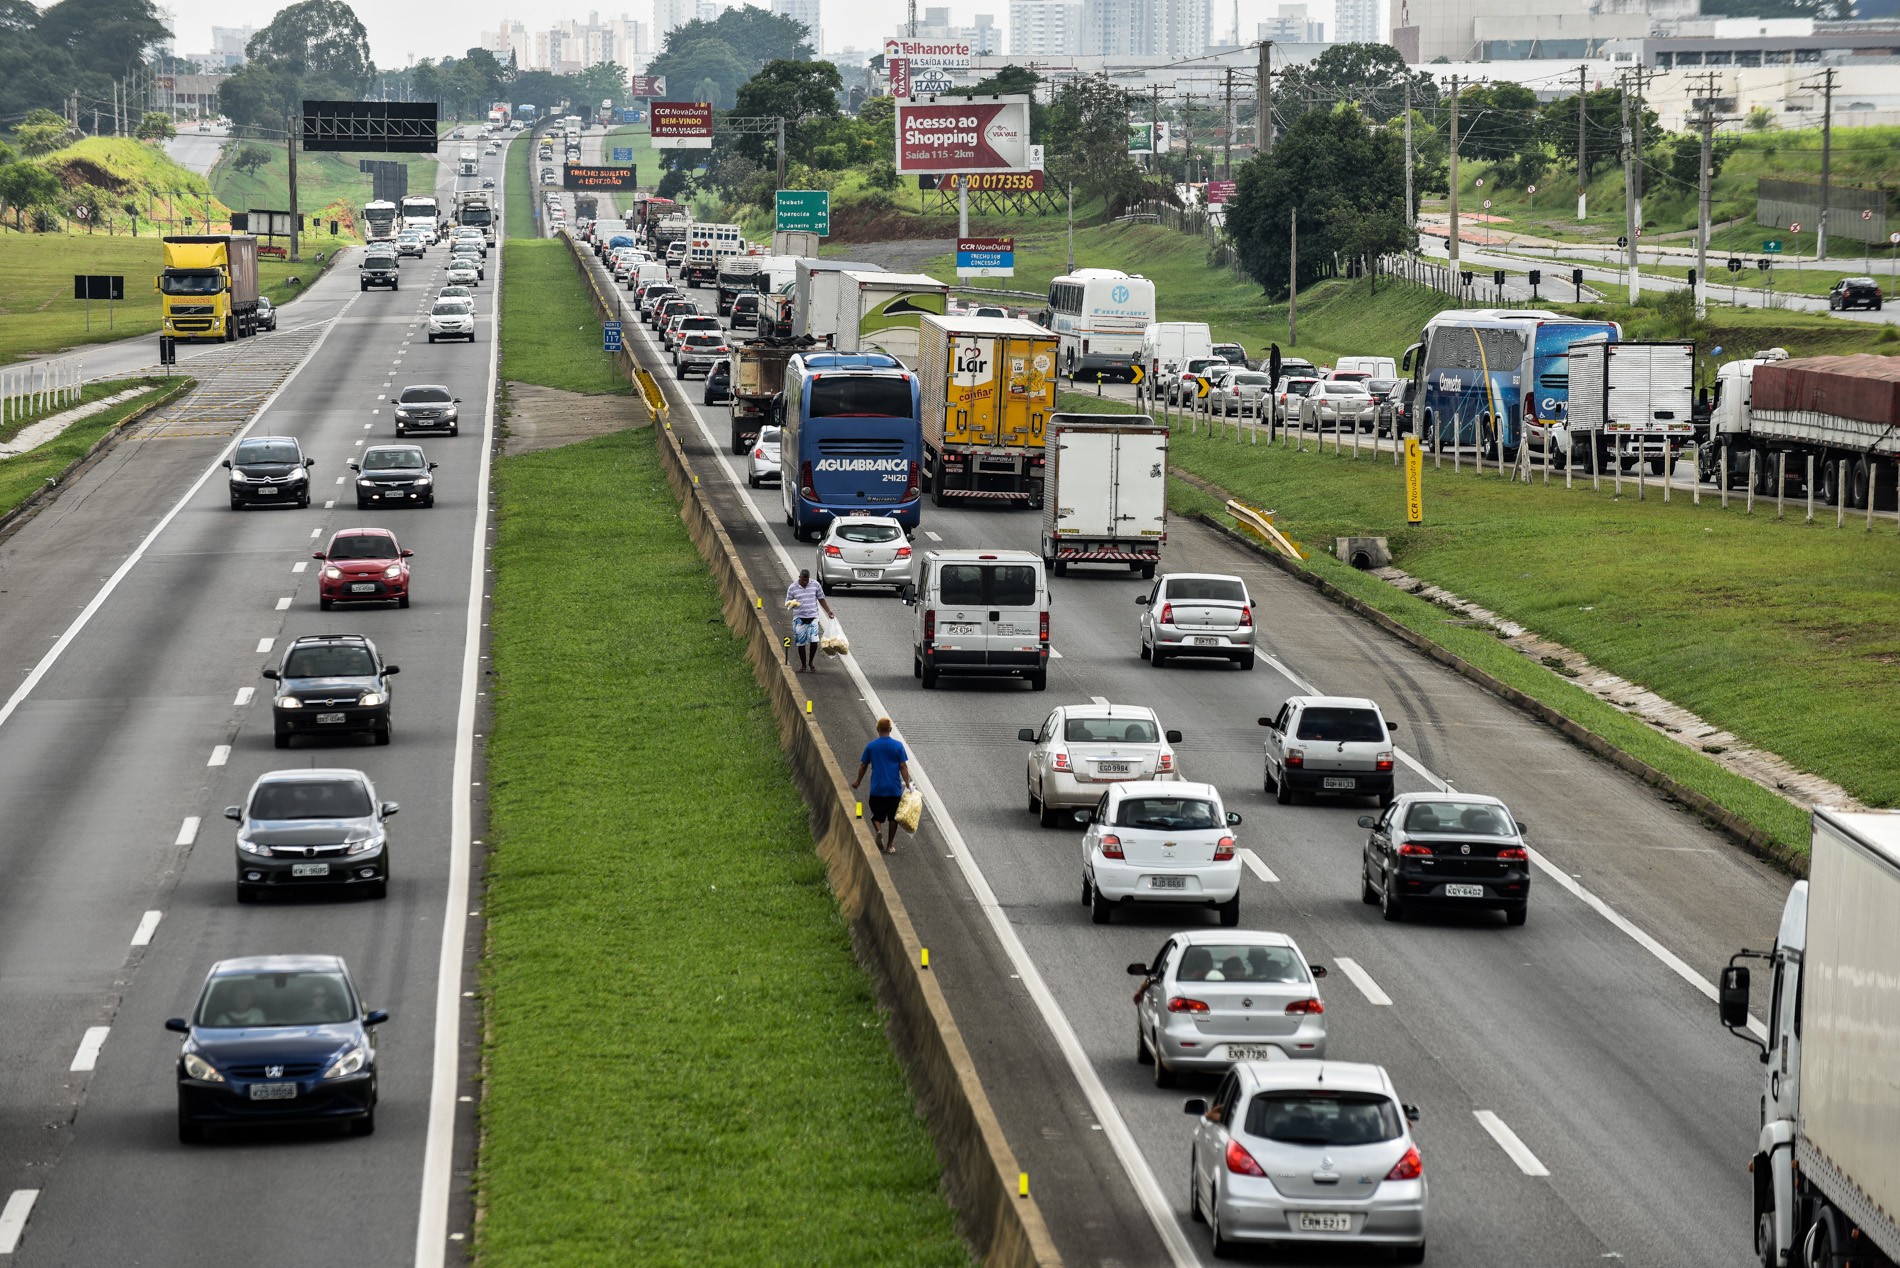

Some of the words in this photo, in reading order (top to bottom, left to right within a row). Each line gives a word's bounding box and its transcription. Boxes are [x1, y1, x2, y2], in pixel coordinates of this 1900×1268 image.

[900, 42, 969, 55] Telhanorte
[920, 57, 941, 66] SAÍDA
[898, 60, 906, 79] VALE
[898, 81, 906, 94] VIA
[915, 80, 953, 92] HAVAN
[671, 108, 708, 116] NovaDutra
[661, 117, 702, 125] BEM-VINDO
[905, 115, 956, 129] Acesso
[958, 117, 978, 128] ao
[905, 130, 978, 147] Shopping
[905, 150, 930, 159] Saída
[954, 149, 975, 158] 2km
[570, 169, 599, 177] TRECHO
[600, 169, 631, 177] SUJEITO
[585, 176, 622, 185] LENTIDÃO
[982, 174, 1034, 189] 0173536
[976, 243, 1012, 251] NovaDutra
[606, 335, 619, 343] 117
[957, 356, 988, 374] Lar
[958, 387, 994, 402] confiar
[882, 474, 908, 482] 24120
[1409, 460, 1418, 501] NovaDutra
[1411, 503, 1419, 519] CCR
[783, 637, 791, 647] 2
